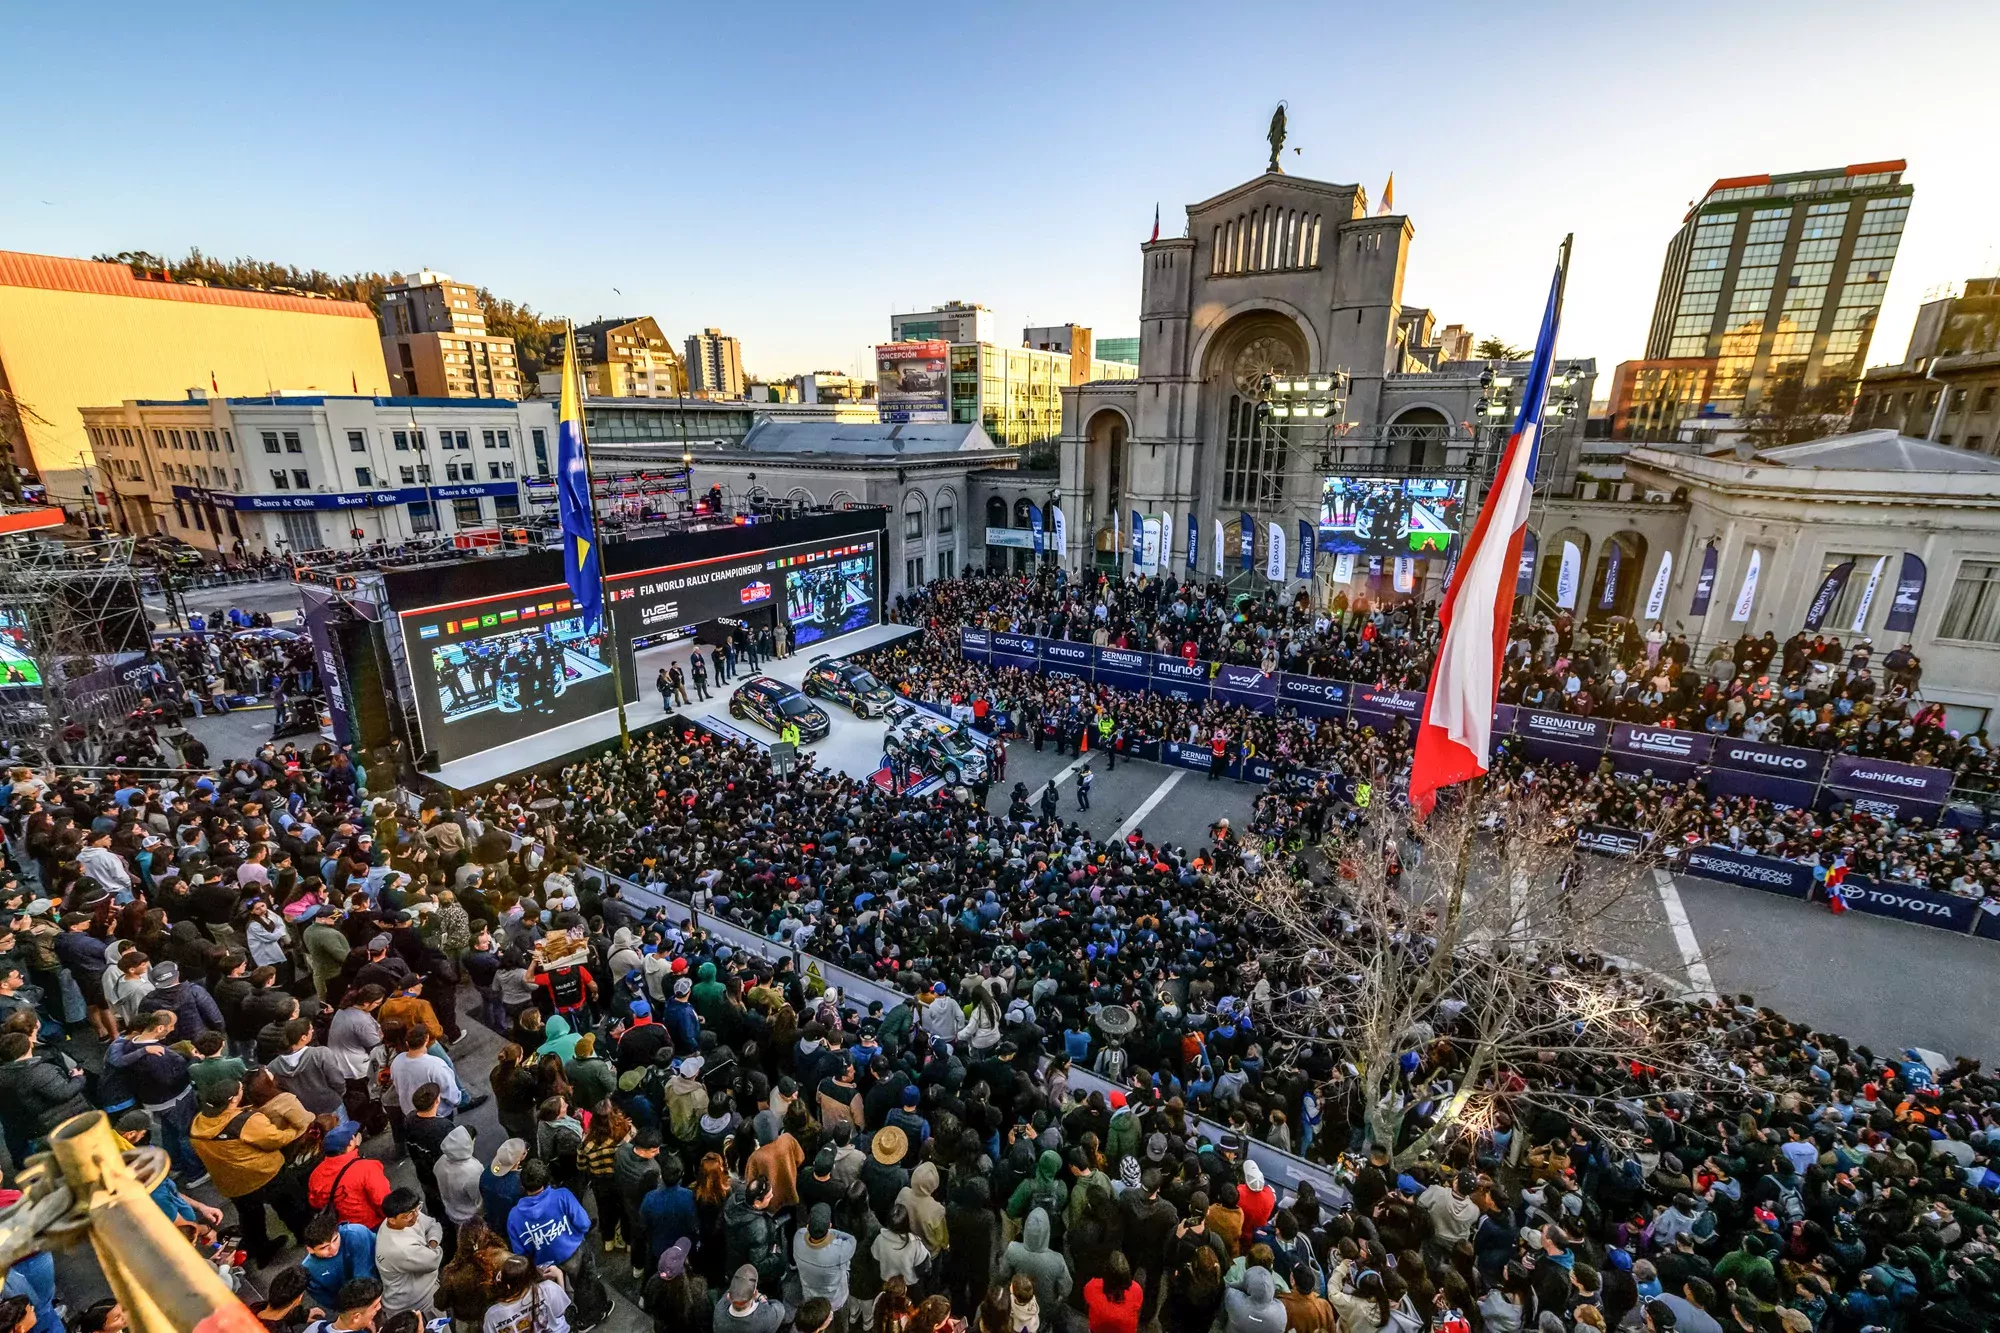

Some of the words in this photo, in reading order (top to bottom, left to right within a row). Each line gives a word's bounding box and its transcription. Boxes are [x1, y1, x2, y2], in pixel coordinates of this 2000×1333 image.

[876, 352, 917, 360] CONCEPCIÓN
[254, 498, 280, 507] Banco
[337, 496, 362, 504] Banco
[640, 585, 654, 596] FIA
[656, 578, 684, 592] WORLD
[686, 574, 709, 586] RALLY
[711, 564, 763, 582] CHAMPIONSHIP
[642, 601, 678, 617] WRC
[1808, 578, 1838, 624] SERNATUR
[995, 638, 1020, 647] COPEC
[1049, 646, 1084, 658] arauco
[1102, 651, 1142, 663] SERNATUR
[1287, 682, 1322, 694] COPEC
[1530, 715, 1596, 732] SERNATUR
[1630, 730, 1694, 748] WRC
[1730, 749, 1807, 769] arauco
[1254, 766, 1317, 786] aruco
[1850, 769, 1927, 787] AsahiKASEI
[1578, 829, 1639, 849] WRC
[1709, 858, 1750, 871] GOBIERNO
[1752, 867, 1792, 880] REGIONAL
[1742, 871, 1757, 879] DEL
[1868, 890, 1952, 918] TOYOTA
[496, 1314, 520, 1328] STAR
